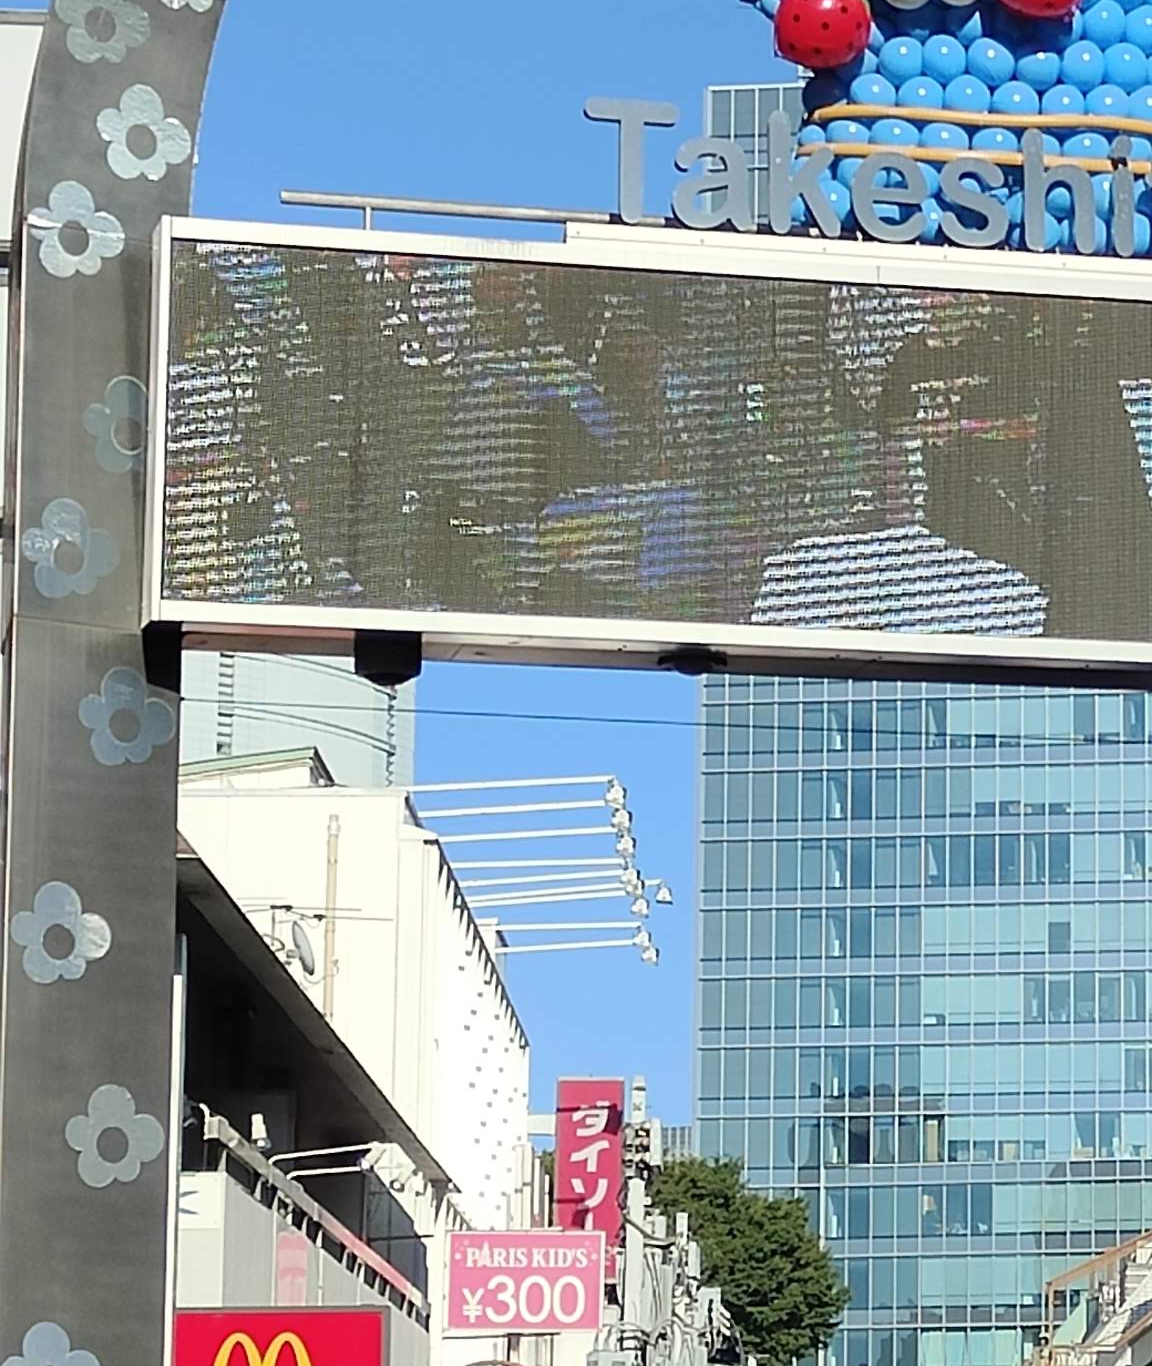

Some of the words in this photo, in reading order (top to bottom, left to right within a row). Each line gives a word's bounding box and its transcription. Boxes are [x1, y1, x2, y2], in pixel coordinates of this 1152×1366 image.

[465, 1240, 528, 1268] PARIS
[531, 1247, 589, 1268] KID'S
[462, 1274, 586, 1323] ¥300
